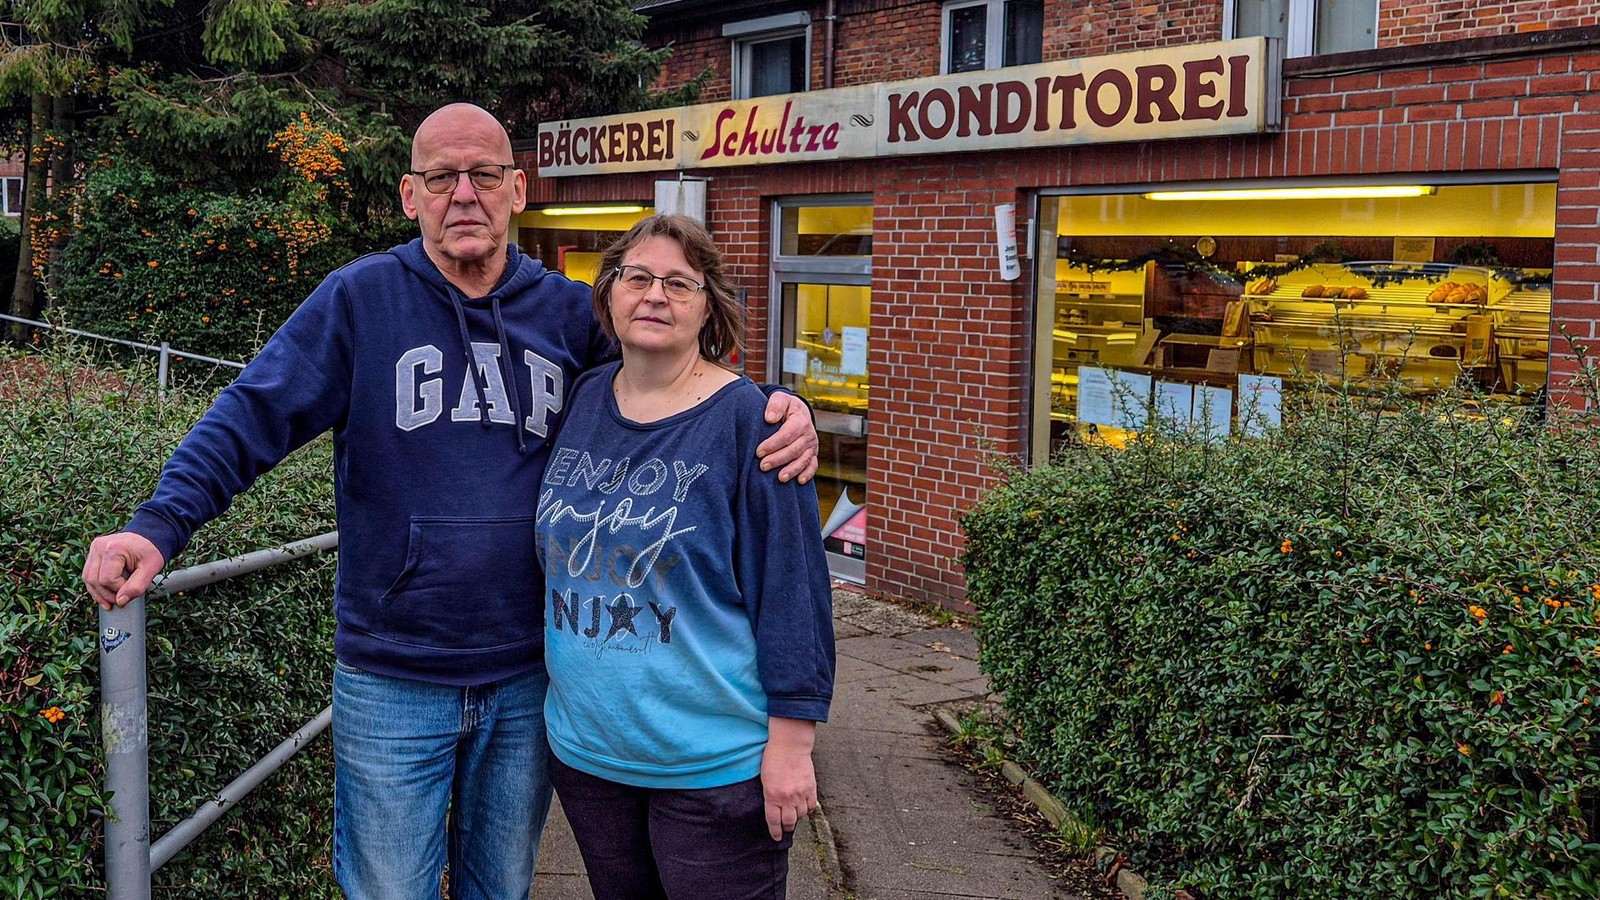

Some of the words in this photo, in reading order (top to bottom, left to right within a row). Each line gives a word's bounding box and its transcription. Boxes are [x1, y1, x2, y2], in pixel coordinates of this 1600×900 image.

[538, 119, 675, 168] BÄCKEREI
[887, 54, 1251, 143] KONDITOREI
[395, 342, 564, 438] GAP
[544, 447, 709, 502] ENJOY
